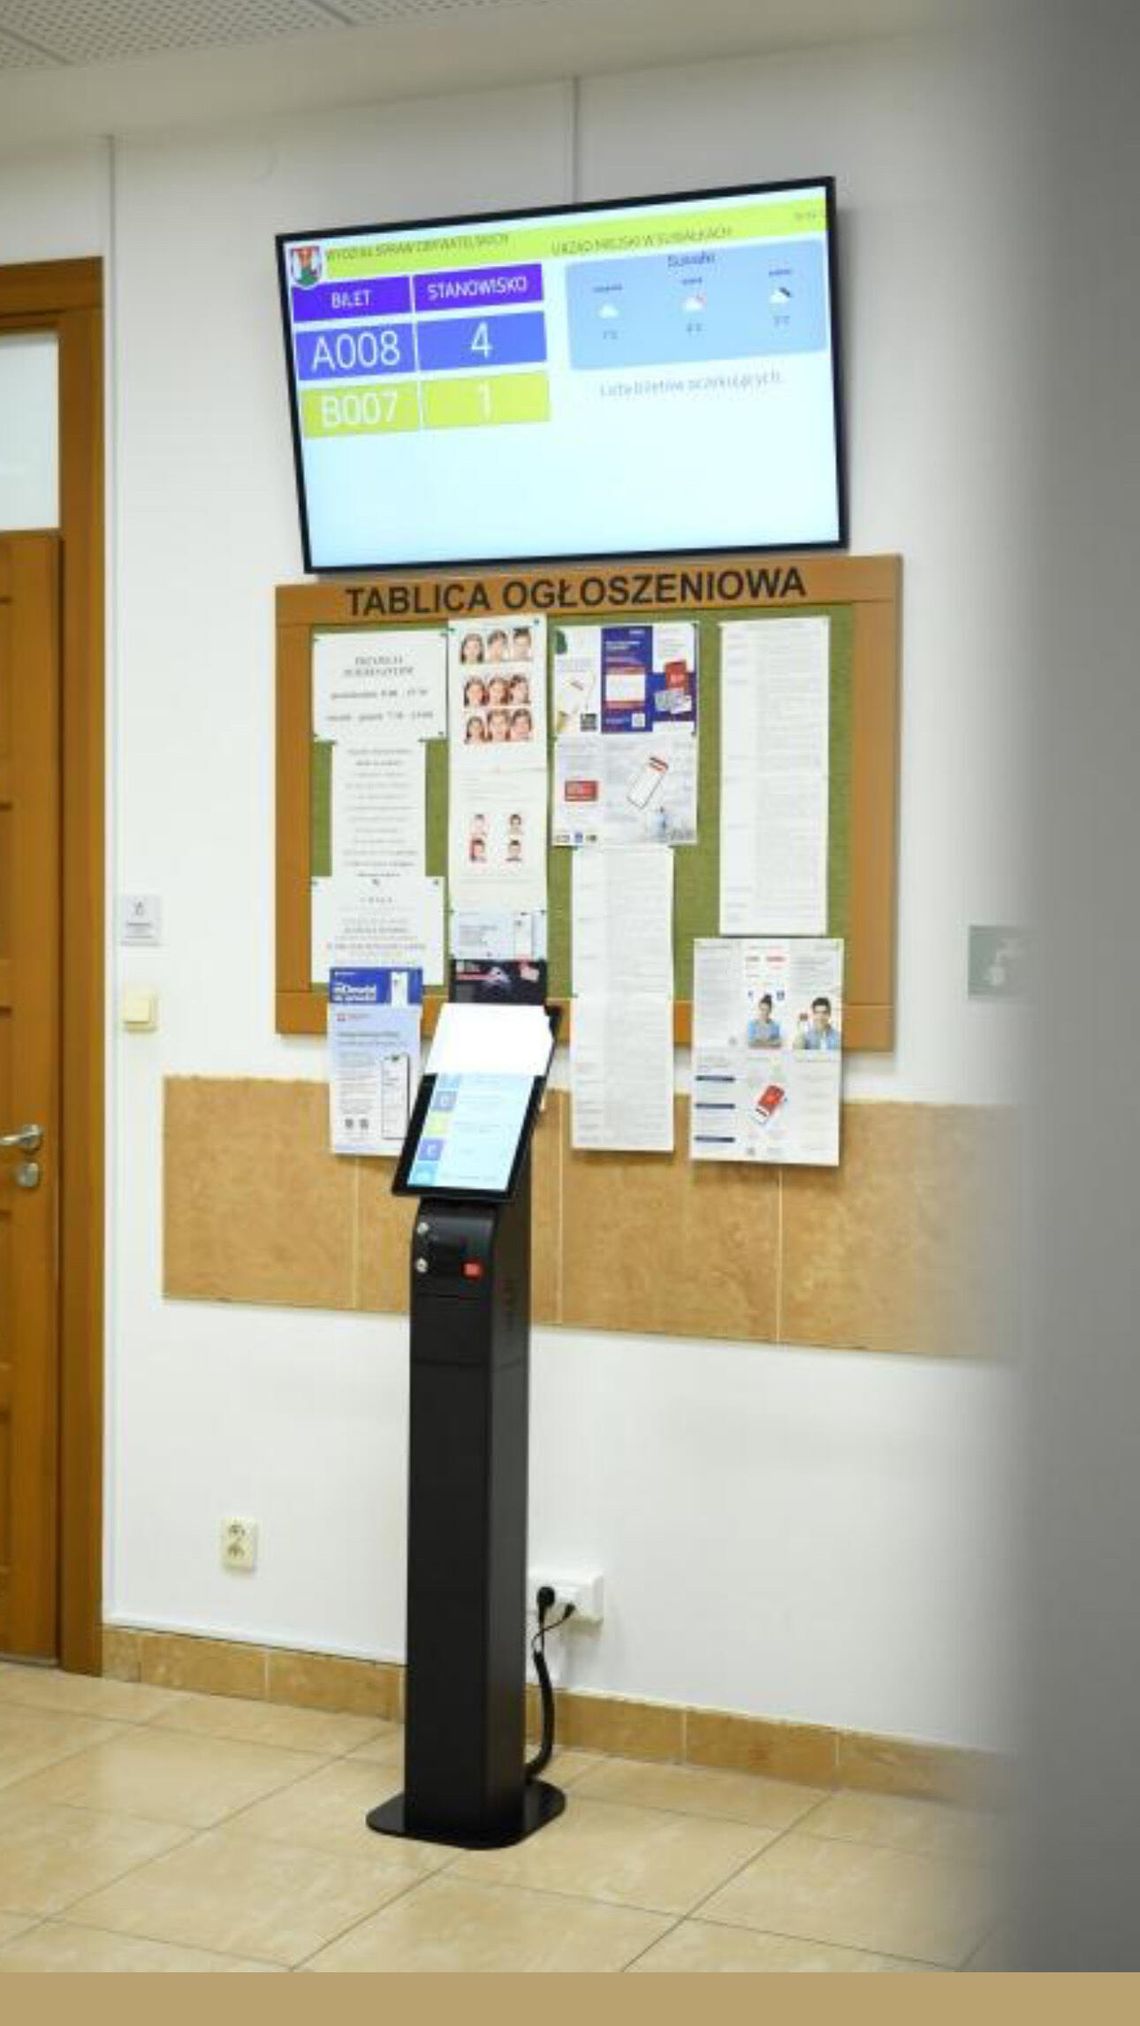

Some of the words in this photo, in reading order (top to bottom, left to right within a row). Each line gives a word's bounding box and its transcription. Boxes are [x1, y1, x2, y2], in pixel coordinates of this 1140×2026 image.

[331, 290, 371, 309] BILET
[427, 276, 528, 301] STANOWISKO
[311, 331, 400, 371] A008
[471, 321, 493, 358] 4
[321, 391, 398, 428] B007
[477, 383, 492, 420] 1
[345, 581, 493, 617] TABLICA
[502, 567, 807, 610] OGŁOSZENIOWA
